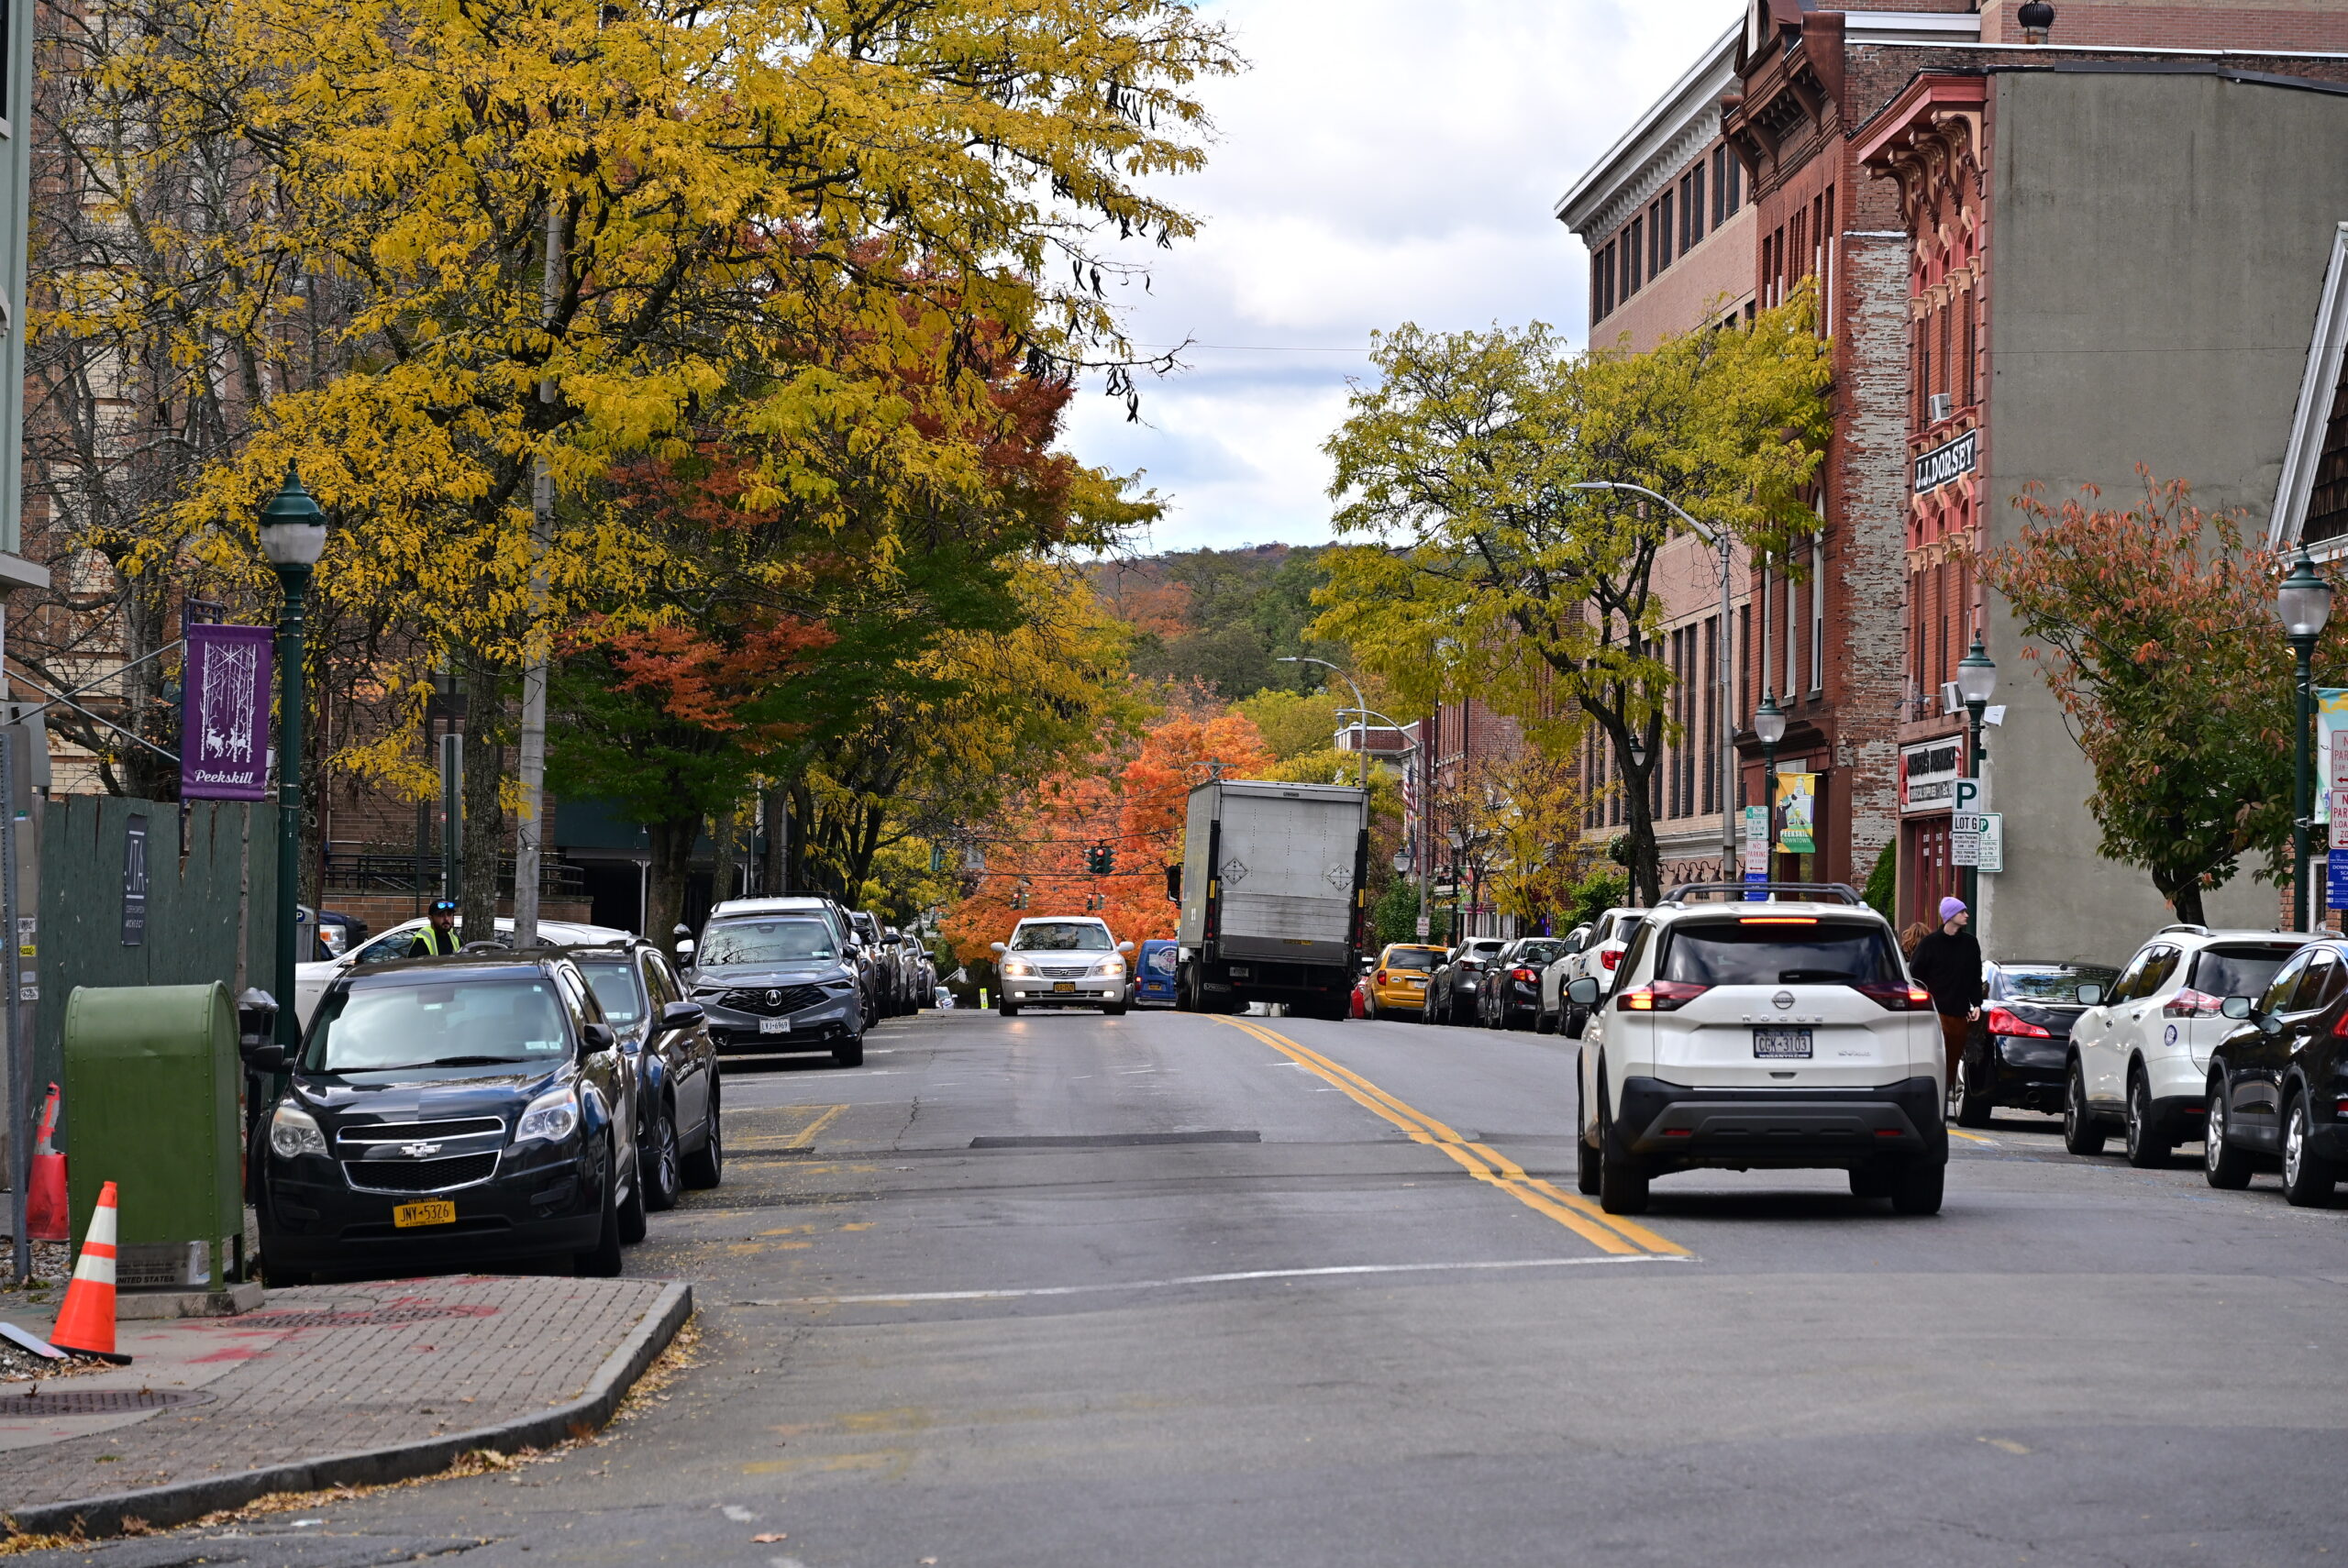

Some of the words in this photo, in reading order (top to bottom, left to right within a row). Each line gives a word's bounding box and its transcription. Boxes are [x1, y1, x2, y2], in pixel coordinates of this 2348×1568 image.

[194, 769, 253, 784] Peekskill
[1957, 782, 1977, 809] P
[1955, 818, 1969, 830] LOT
[1972, 818, 1977, 830] G
